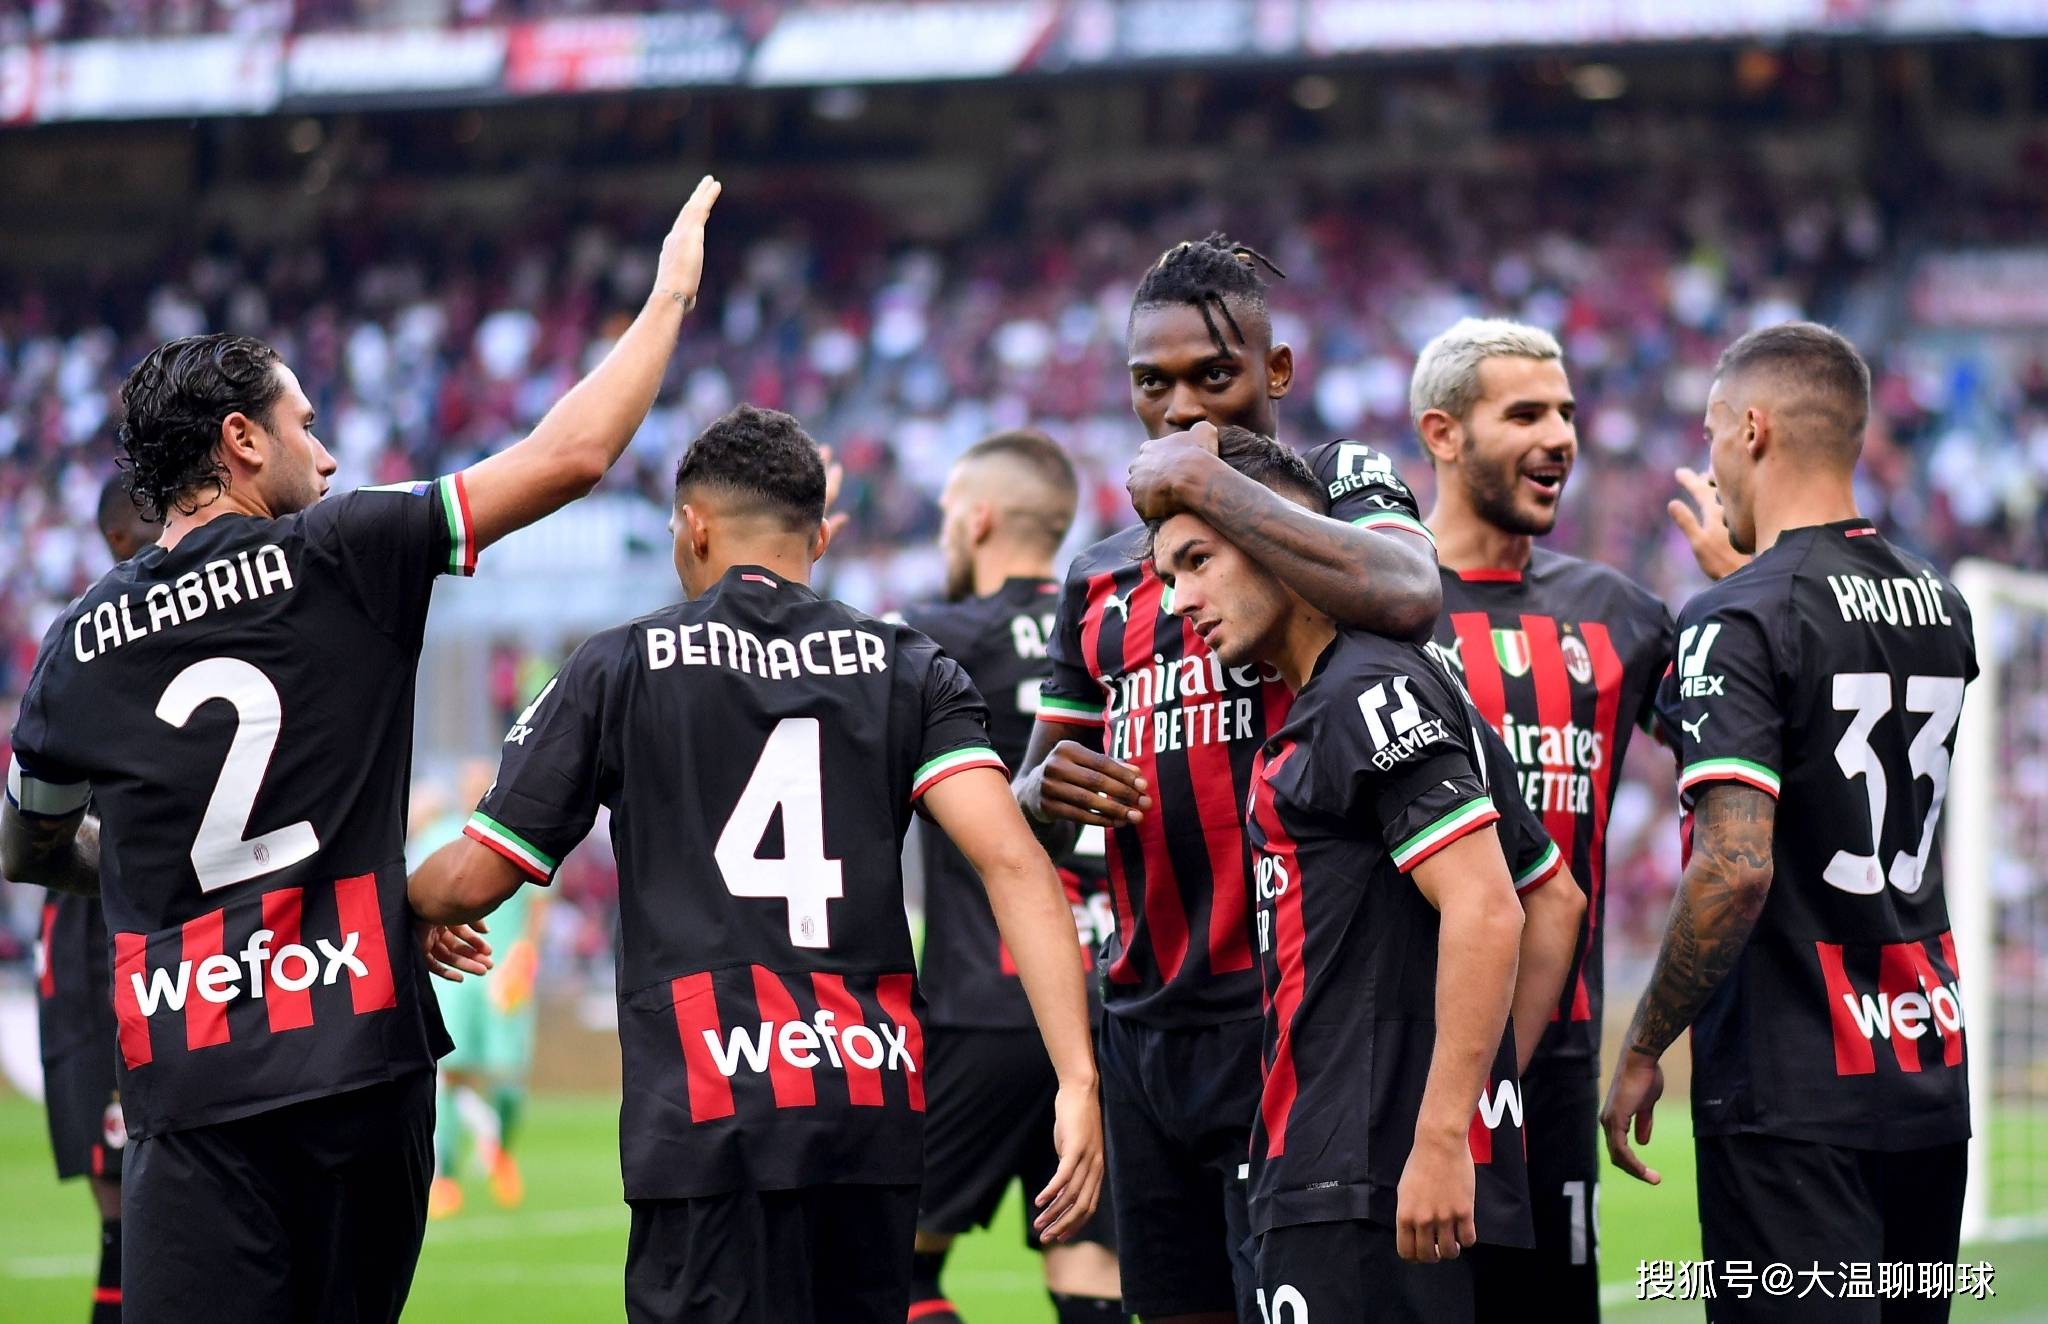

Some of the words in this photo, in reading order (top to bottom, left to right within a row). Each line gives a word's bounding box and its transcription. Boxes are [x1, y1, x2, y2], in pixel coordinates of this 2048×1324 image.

[74, 544, 295, 663] CALABRIA
[1826, 569, 1952, 627] KRUNIĆ
[647, 622, 888, 680] BENNACER
[1113, 716, 1146, 760] FLY
[1154, 698, 1253, 753] BETTER
[1371, 718, 1449, 771] BitMEX
[155, 657, 319, 893] 2
[1517, 770, 1590, 814] ETTER
[1822, 672, 1965, 895] 33
[713, 717, 844, 949] 4
[131, 930, 369, 1017] wefox
[702, 1010, 917, 1077] wefox
